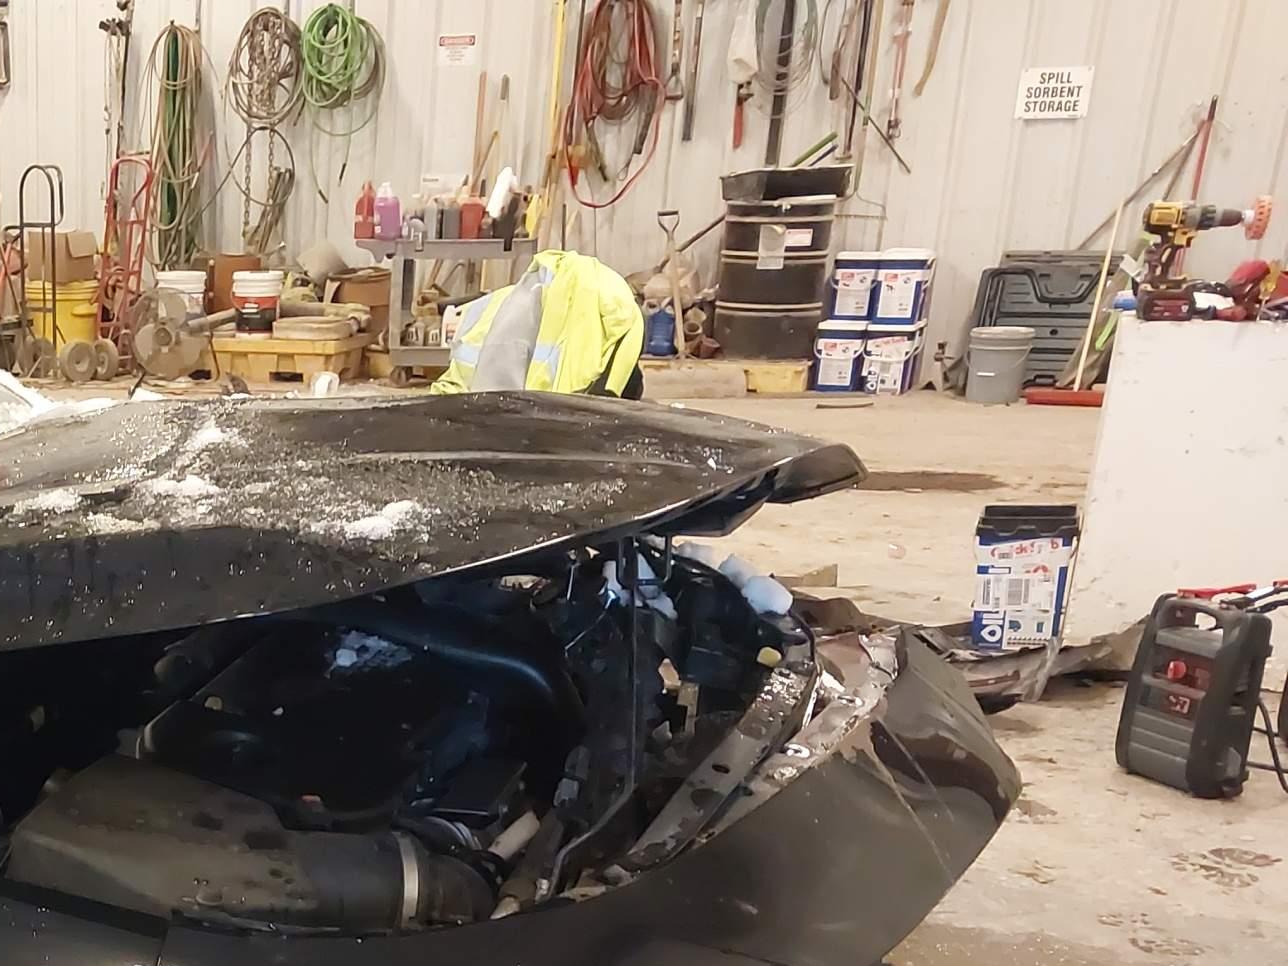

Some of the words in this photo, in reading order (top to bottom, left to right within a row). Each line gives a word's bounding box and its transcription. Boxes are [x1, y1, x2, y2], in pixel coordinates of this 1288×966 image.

[1039, 72, 1073, 85] SPILL
[1026, 86, 1084, 99] SORBENT
[1024, 100, 1080, 113] STORAGE
